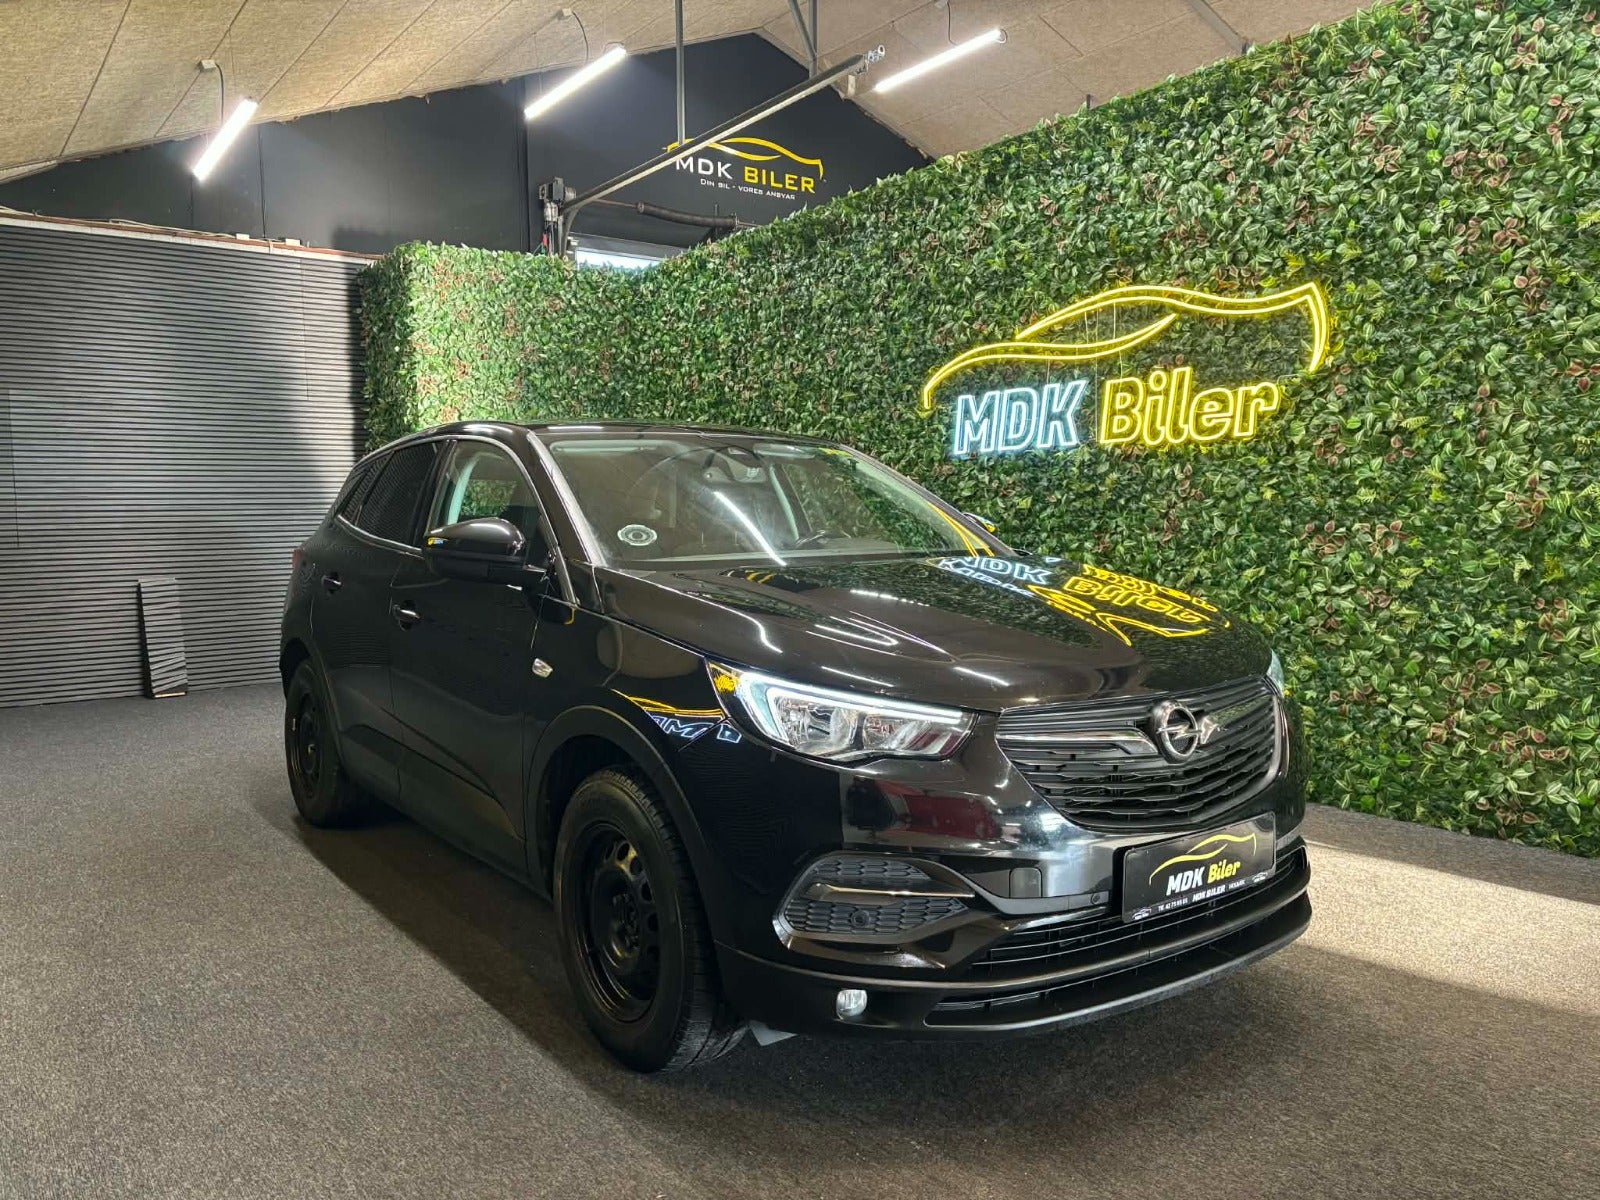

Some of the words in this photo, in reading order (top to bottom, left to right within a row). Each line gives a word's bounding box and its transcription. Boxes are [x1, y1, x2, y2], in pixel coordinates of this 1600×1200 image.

[675, 156, 733, 180] MDK
[744, 166, 816, 194] BILER
[953, 379, 1088, 455] MDK
[1099, 366, 1281, 446] Biler
[1166, 866, 1205, 896] MDK
[1207, 859, 1241, 884] Biler
[1206, 884, 1226, 898] BILER
